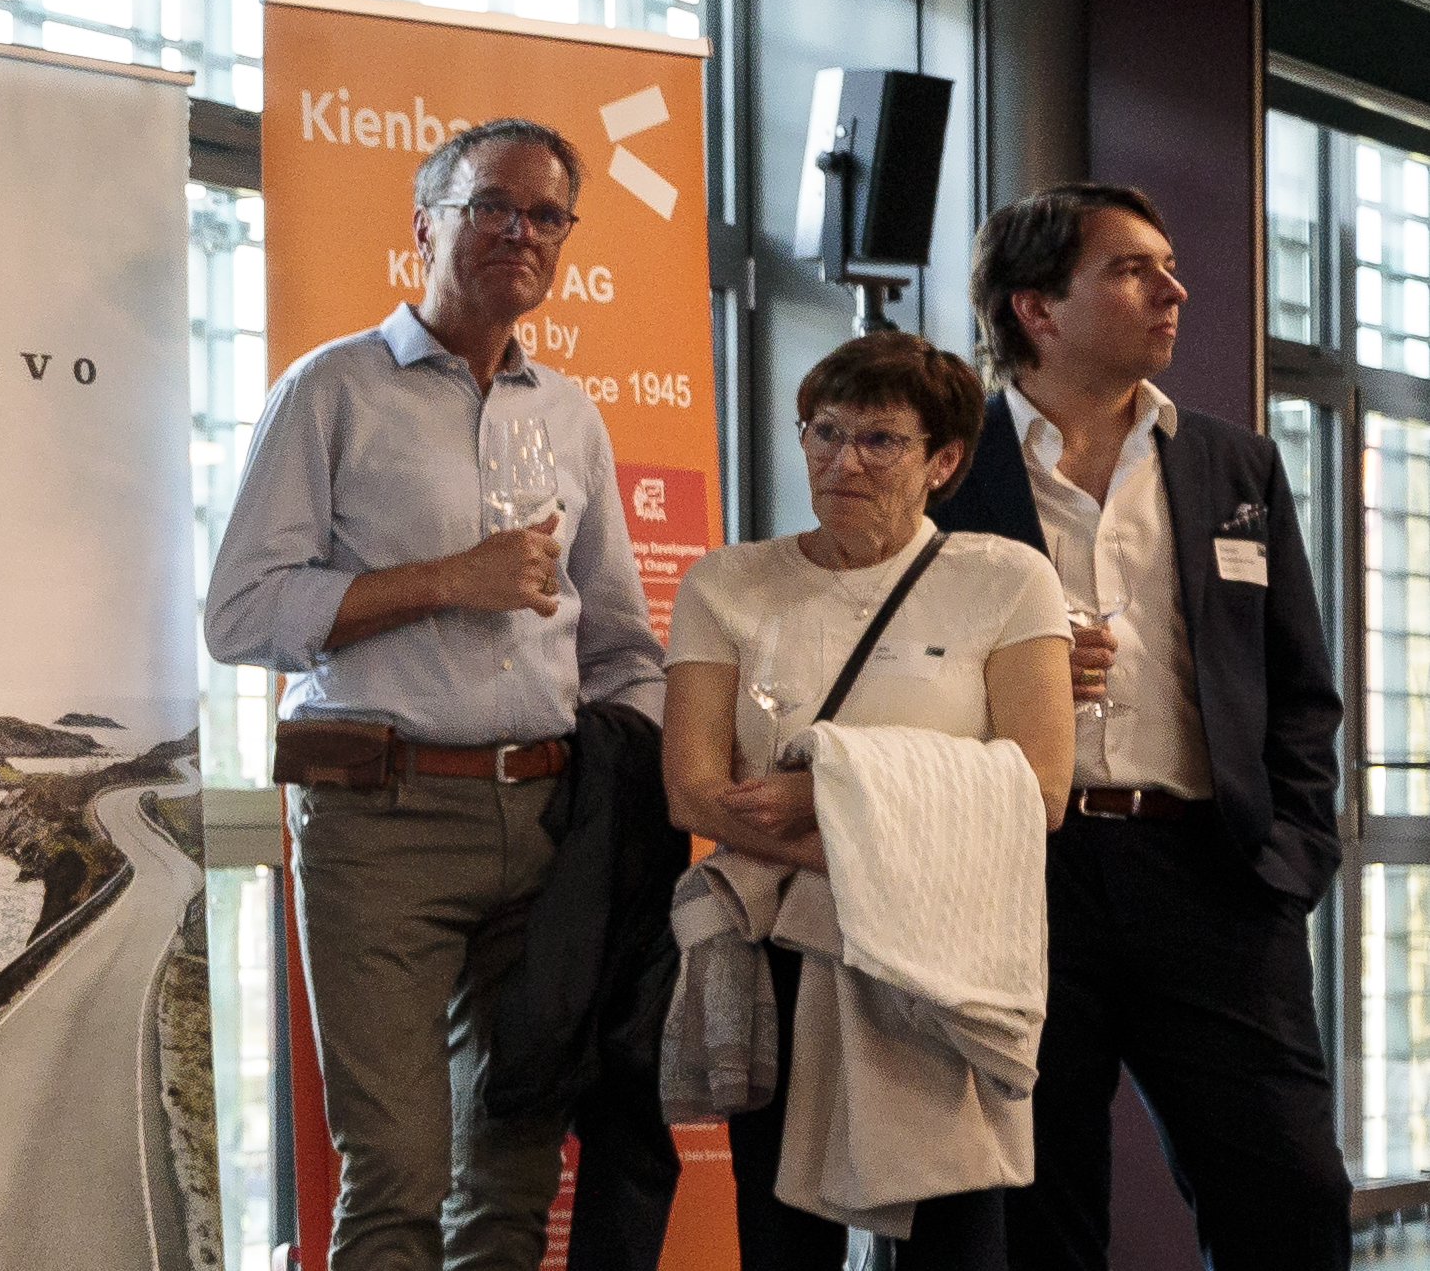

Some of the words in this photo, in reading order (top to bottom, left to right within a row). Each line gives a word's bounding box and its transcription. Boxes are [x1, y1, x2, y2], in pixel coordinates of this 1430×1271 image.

[301, 88, 480, 153] Kienb
[561, 263, 615, 304] AG
[545, 316, 580, 360] by
[628, 370, 692, 409] 1945
